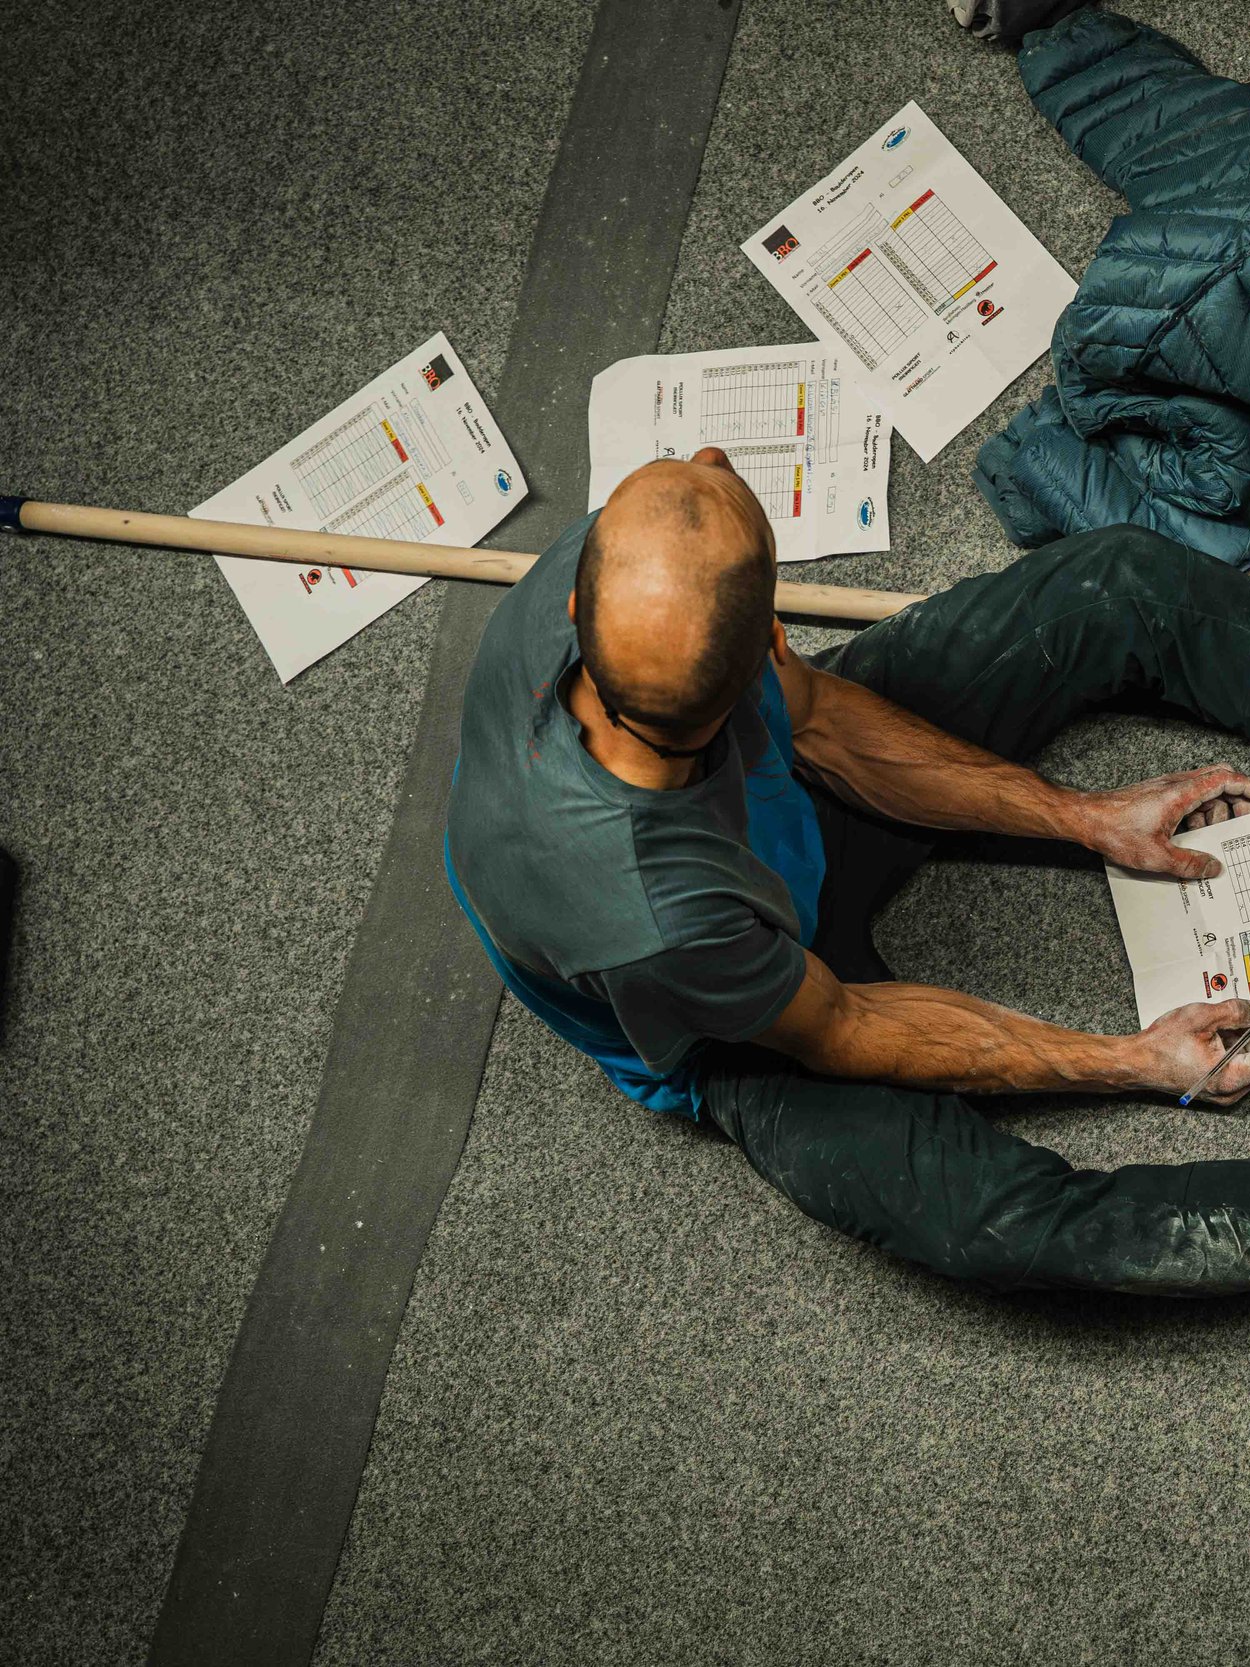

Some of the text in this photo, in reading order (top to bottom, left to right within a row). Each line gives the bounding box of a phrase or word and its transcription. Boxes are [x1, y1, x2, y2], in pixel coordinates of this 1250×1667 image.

[826, 182, 853, 206] November
[850, 169, 865, 183] 2024
[812, 194, 825, 206] BBO
[770, 235, 799, 262] BBO
[905, 351, 921, 367] SPORT
[419, 362, 443, 391] BBO
[1204, 880, 1213, 899] SPORT
